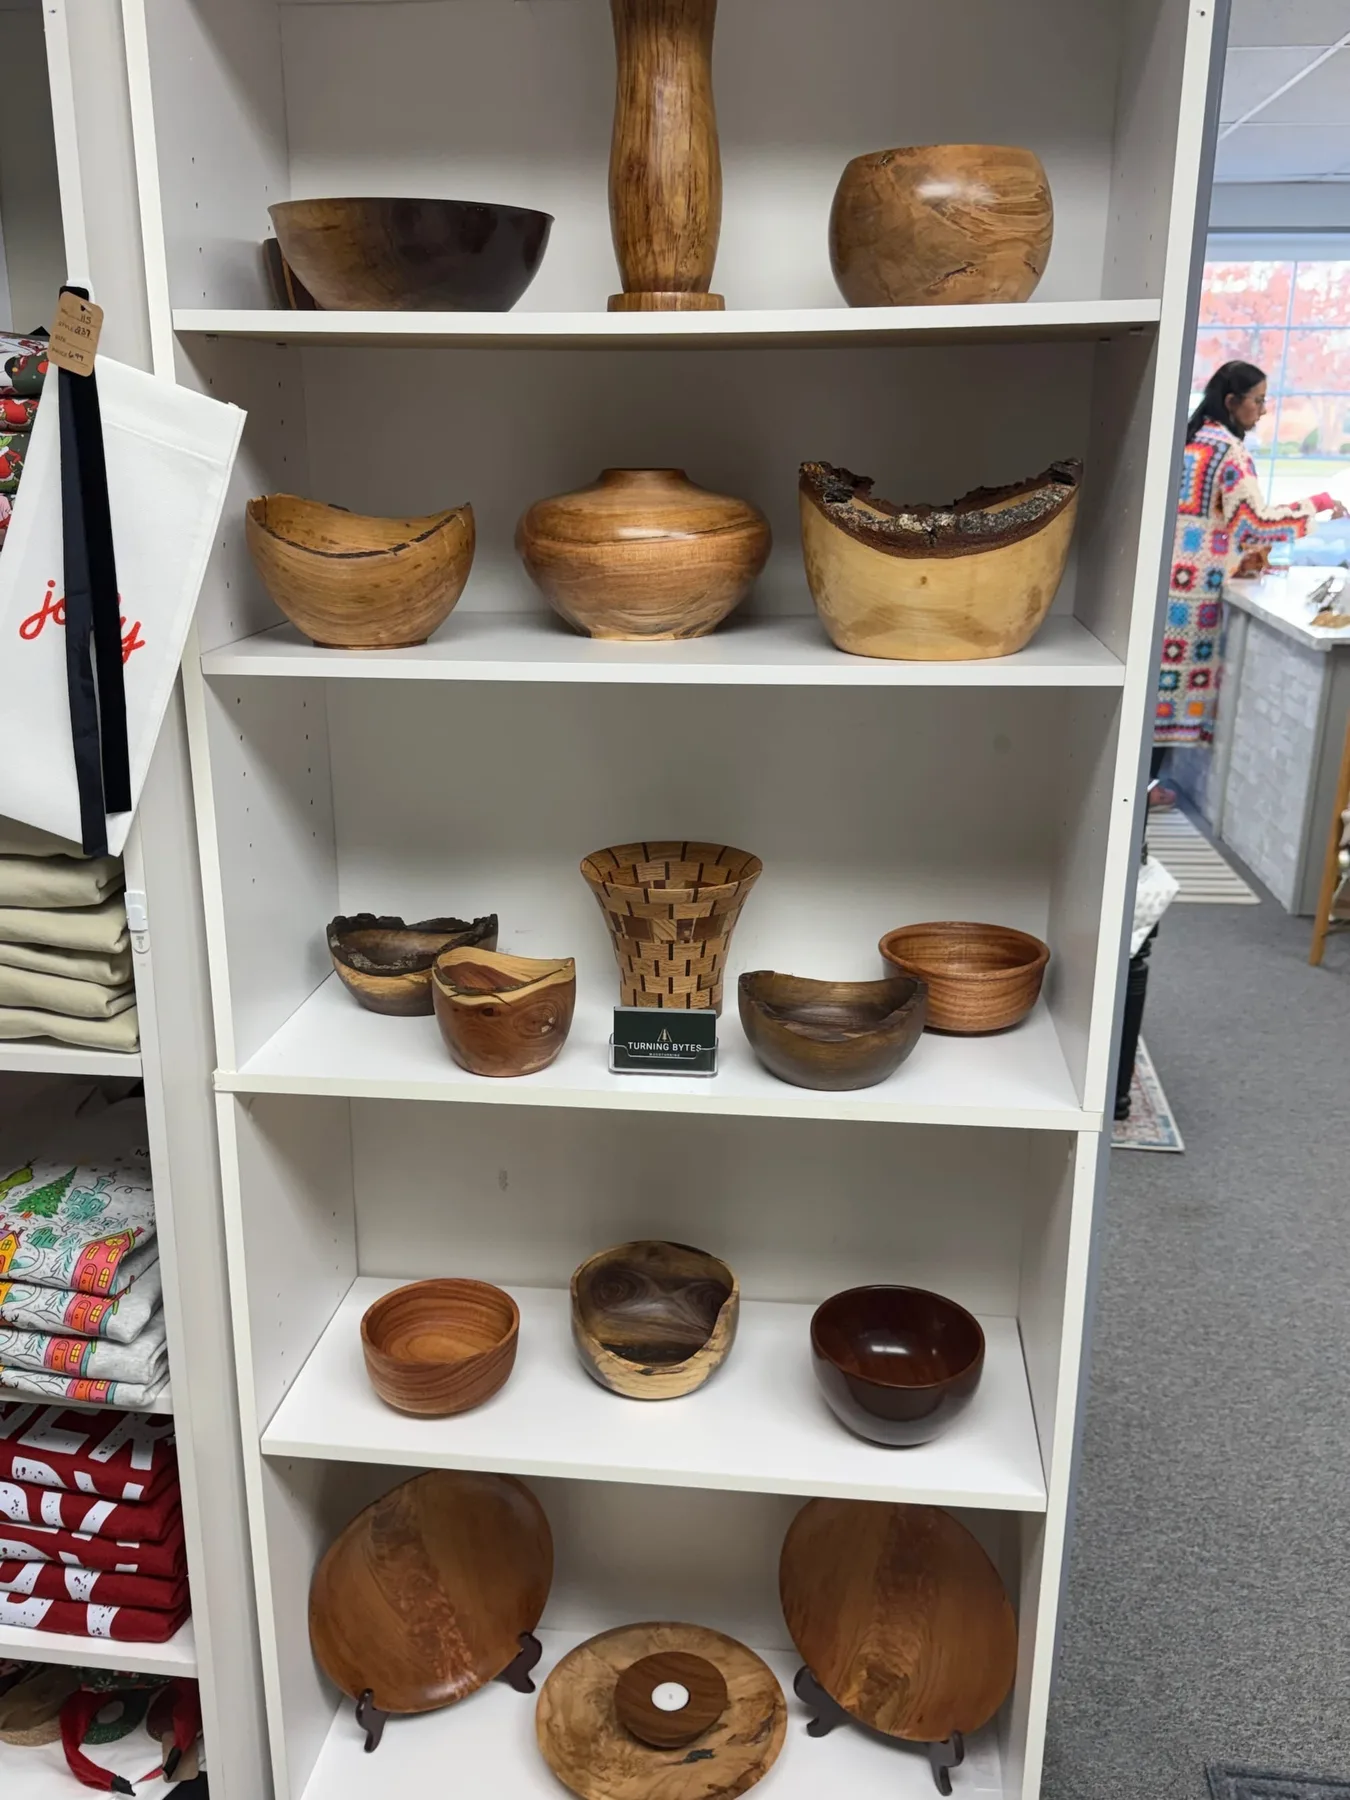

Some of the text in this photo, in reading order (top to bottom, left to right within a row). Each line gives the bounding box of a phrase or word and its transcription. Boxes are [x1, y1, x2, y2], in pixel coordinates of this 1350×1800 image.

[19, 579, 146, 664] joy
[628, 1041, 702, 1053] TURNING BYTES
